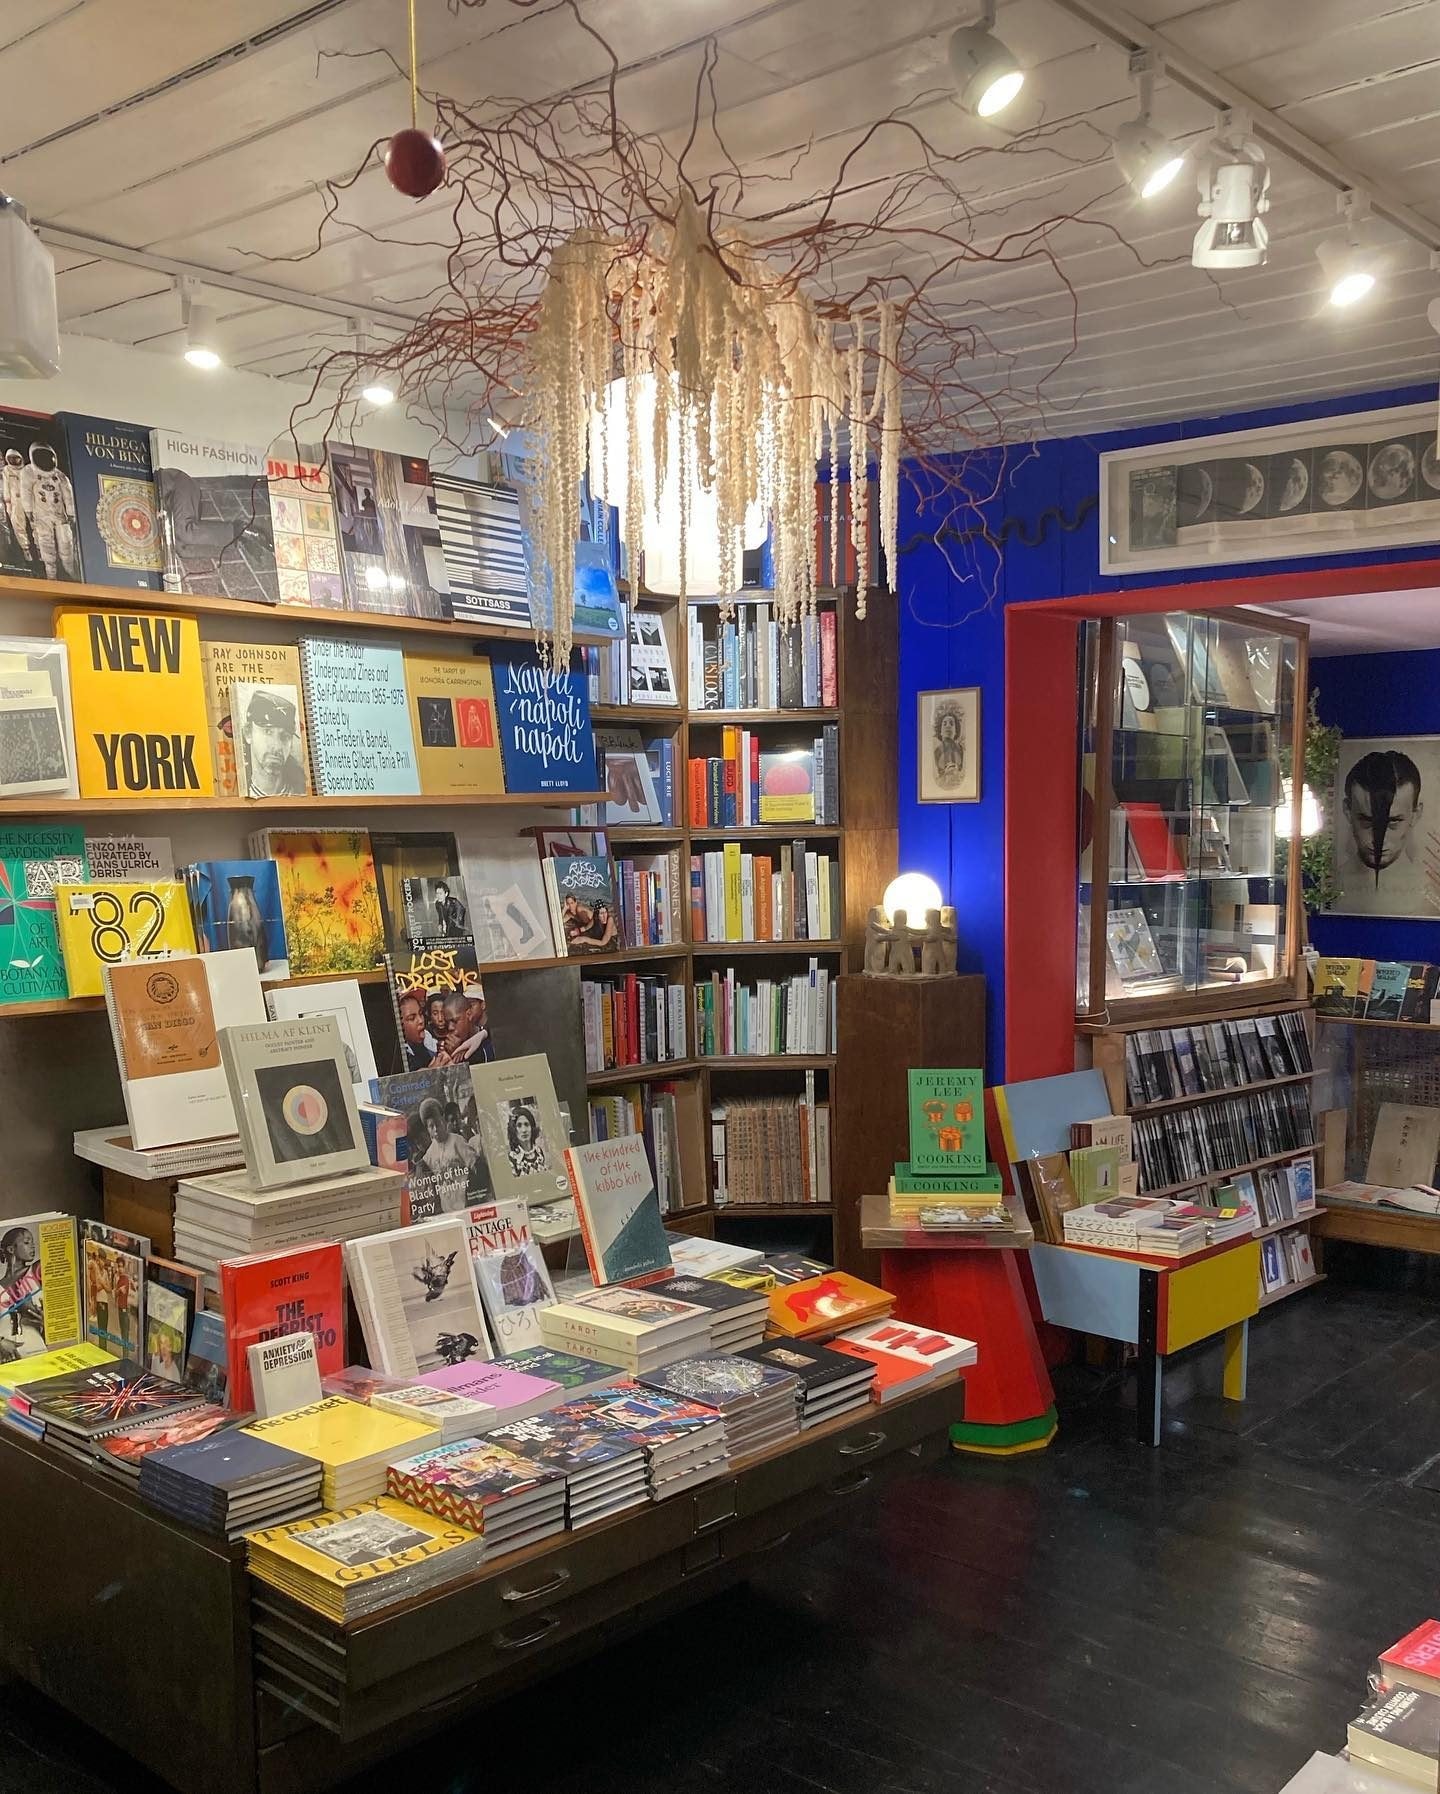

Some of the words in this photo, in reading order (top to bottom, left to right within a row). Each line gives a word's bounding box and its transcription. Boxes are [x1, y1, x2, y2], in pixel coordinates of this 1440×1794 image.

[85, 431, 148, 453] HILDEGA
[85, 444, 116, 460] VON
[167, 439, 199, 456] HIGH
[202, 447, 258, 466] FASHION
[465, 594, 511, 611] SOTTSASS
[88, 614, 181, 674] NEW
[312, 640, 333, 657] Under
[334, 640, 344, 657] the
[344, 641, 365, 658] Radar
[213, 648, 231, 659] RAY
[235, 648, 287, 661] JOHNSON
[704, 644, 718, 675] CAPS
[215, 662, 234, 673] ARE
[242, 663, 264, 674] THE
[315, 663, 356, 683] Underground
[358, 664, 376, 681] Zines
[377, 665, 389, 682] and
[216, 675, 274, 686] FUNNIEST
[704, 675, 718, 706] LOCK
[319, 707, 341, 726] Edited
[341, 711, 350, 730] by
[321, 729, 365, 748] Jan-Frederik
[515, 725, 584, 768] napoli
[93, 732, 200, 791] YORK
[325, 752, 351, 769] Annette
[377, 752, 395, 769] Tania
[396, 752, 411, 769] Prill
[327, 773, 354, 793] Spector
[355, 773, 375, 790] Books
[726, 765, 735, 787] JUDD
[0, 833, 18, 845] HE
[21, 833, 75, 845] NECESSITY
[86, 842, 116, 852] ENZO
[117, 842, 144, 852] MARI
[87, 851, 137, 861] CURATED
[138, 851, 152, 860] BY
[88, 860, 119, 869] HANS
[120, 860, 160, 869] ULRICH
[89, 869, 128, 879] OBRIST
[403, 878, 415, 913] ROCKERS
[671, 854, 681, 919] PAPANEK
[30, 923, 46, 934] OF
[410, 950, 459, 973] LOST
[2, 966, 48, 981] BOTANY
[50, 966, 65, 979] AN
[395, 968, 478, 994] DREAMS
[240, 1028, 280, 1042] HILMA
[282, 1026, 297, 1039] AF
[299, 1023, 332, 1038] KLINT
[388, 1078, 431, 1096] Comrade
[916, 1077, 977, 1087] JEREMY
[933, 1087, 962, 1097] LEE
[600, 1142, 640, 1160] kindred
[917, 1154, 982, 1165] COOKING
[408, 1171, 442, 1189] Women
[441, 1169, 452, 1183] of
[453, 1165, 469, 1177] the
[408, 1186, 434, 1203] Black
[435, 1178, 470, 1198] Panther
[913, 1182, 980, 1192] COOKING
[411, 1201, 436, 1215] Party
[467, 1217, 512, 1238] INTAGE
[468, 1225, 529, 1256] ENIM
[270, 1276, 291, 1289] SCOTT
[292, 1271, 310, 1285] KING
[275, 1300, 305, 1323] THE
[564, 1322, 598, 1337] TAROT
[263, 1344, 297, 1361] ANXIETY
[566, 1341, 599, 1356] TAROT
[264, 1349, 314, 1371] DEPRESSION
[447, 1372, 503, 1395] illmans
[463, 1383, 502, 1400] eader
[283, 1397, 349, 1422] cricket
[487, 1416, 544, 1438] NUCLEAR
[409, 1440, 471, 1465] WOMEN
[410, 1456, 440, 1474] FOR
[440, 1443, 492, 1465] PEAC
[252, 1497, 388, 1545] TEDDY
[334, 1528, 469, 1582] GIRLS
